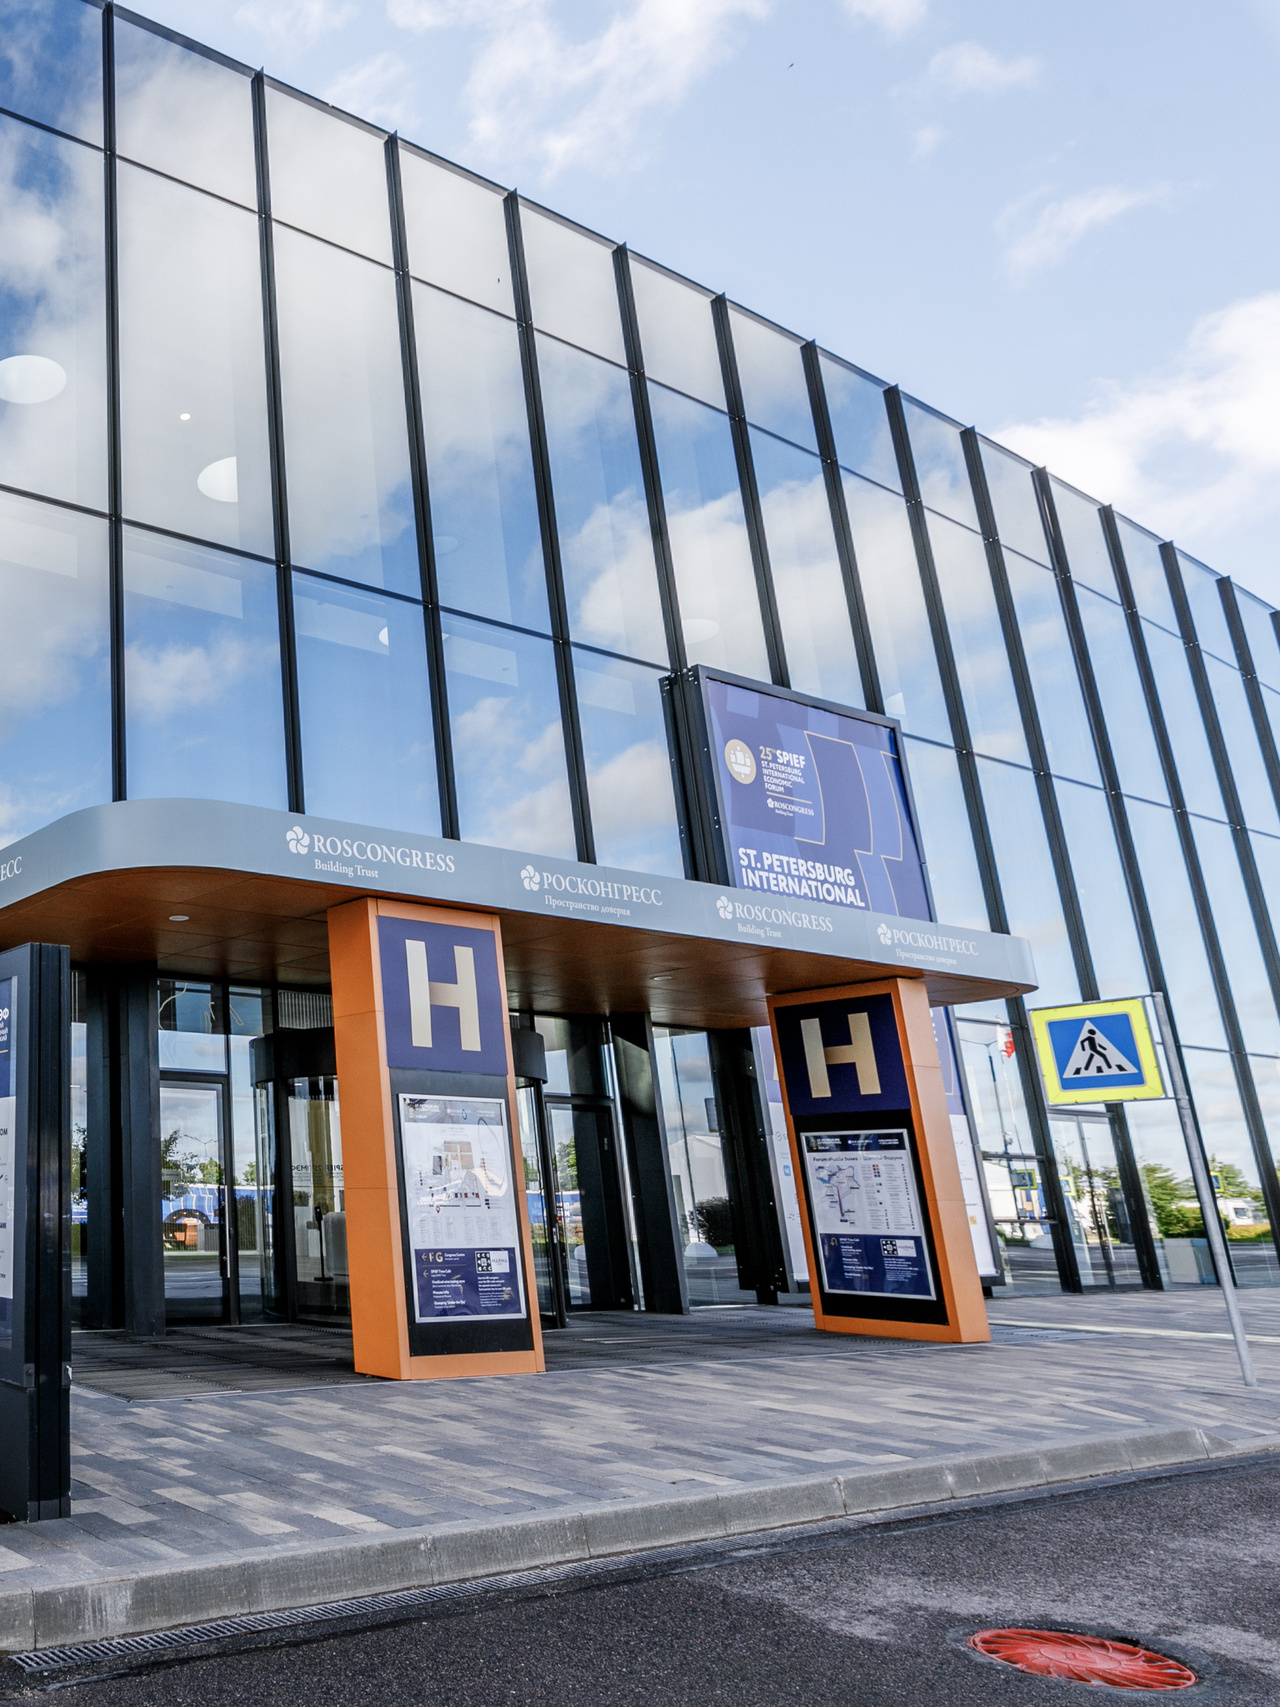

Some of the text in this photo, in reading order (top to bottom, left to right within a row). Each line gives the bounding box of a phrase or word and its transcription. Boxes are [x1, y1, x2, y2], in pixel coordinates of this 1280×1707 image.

[769, 762, 802, 776] PETERSBURG
[776, 750, 805, 768] SPIEF
[762, 768, 805, 784] INTERNATIONAL
[763, 775, 793, 788] ECONOMIC
[764, 782, 785, 793] FORUM
[774, 801, 815, 816] ROSCONGRESS
[313, 834, 455, 873] ROSCONGRESS
[314, 858, 379, 878] Building Trust
[738, 847, 855, 886] ST. PETERSBURG
[542, 873, 663, 907] РОСКОНГРЕСС
[741, 867, 866, 907] INTERNATIONAL
[544, 894, 631, 917] Пространство доверия
[734, 902, 833, 933] ROSCONGRESS
[737, 922, 782, 938] Building Trust
[892, 928, 979, 957] РОСКОНГРЕСС
[895, 947, 934, 963] Пространство
[405, 939, 482, 1052] H
[799, 1012, 882, 1098] H
